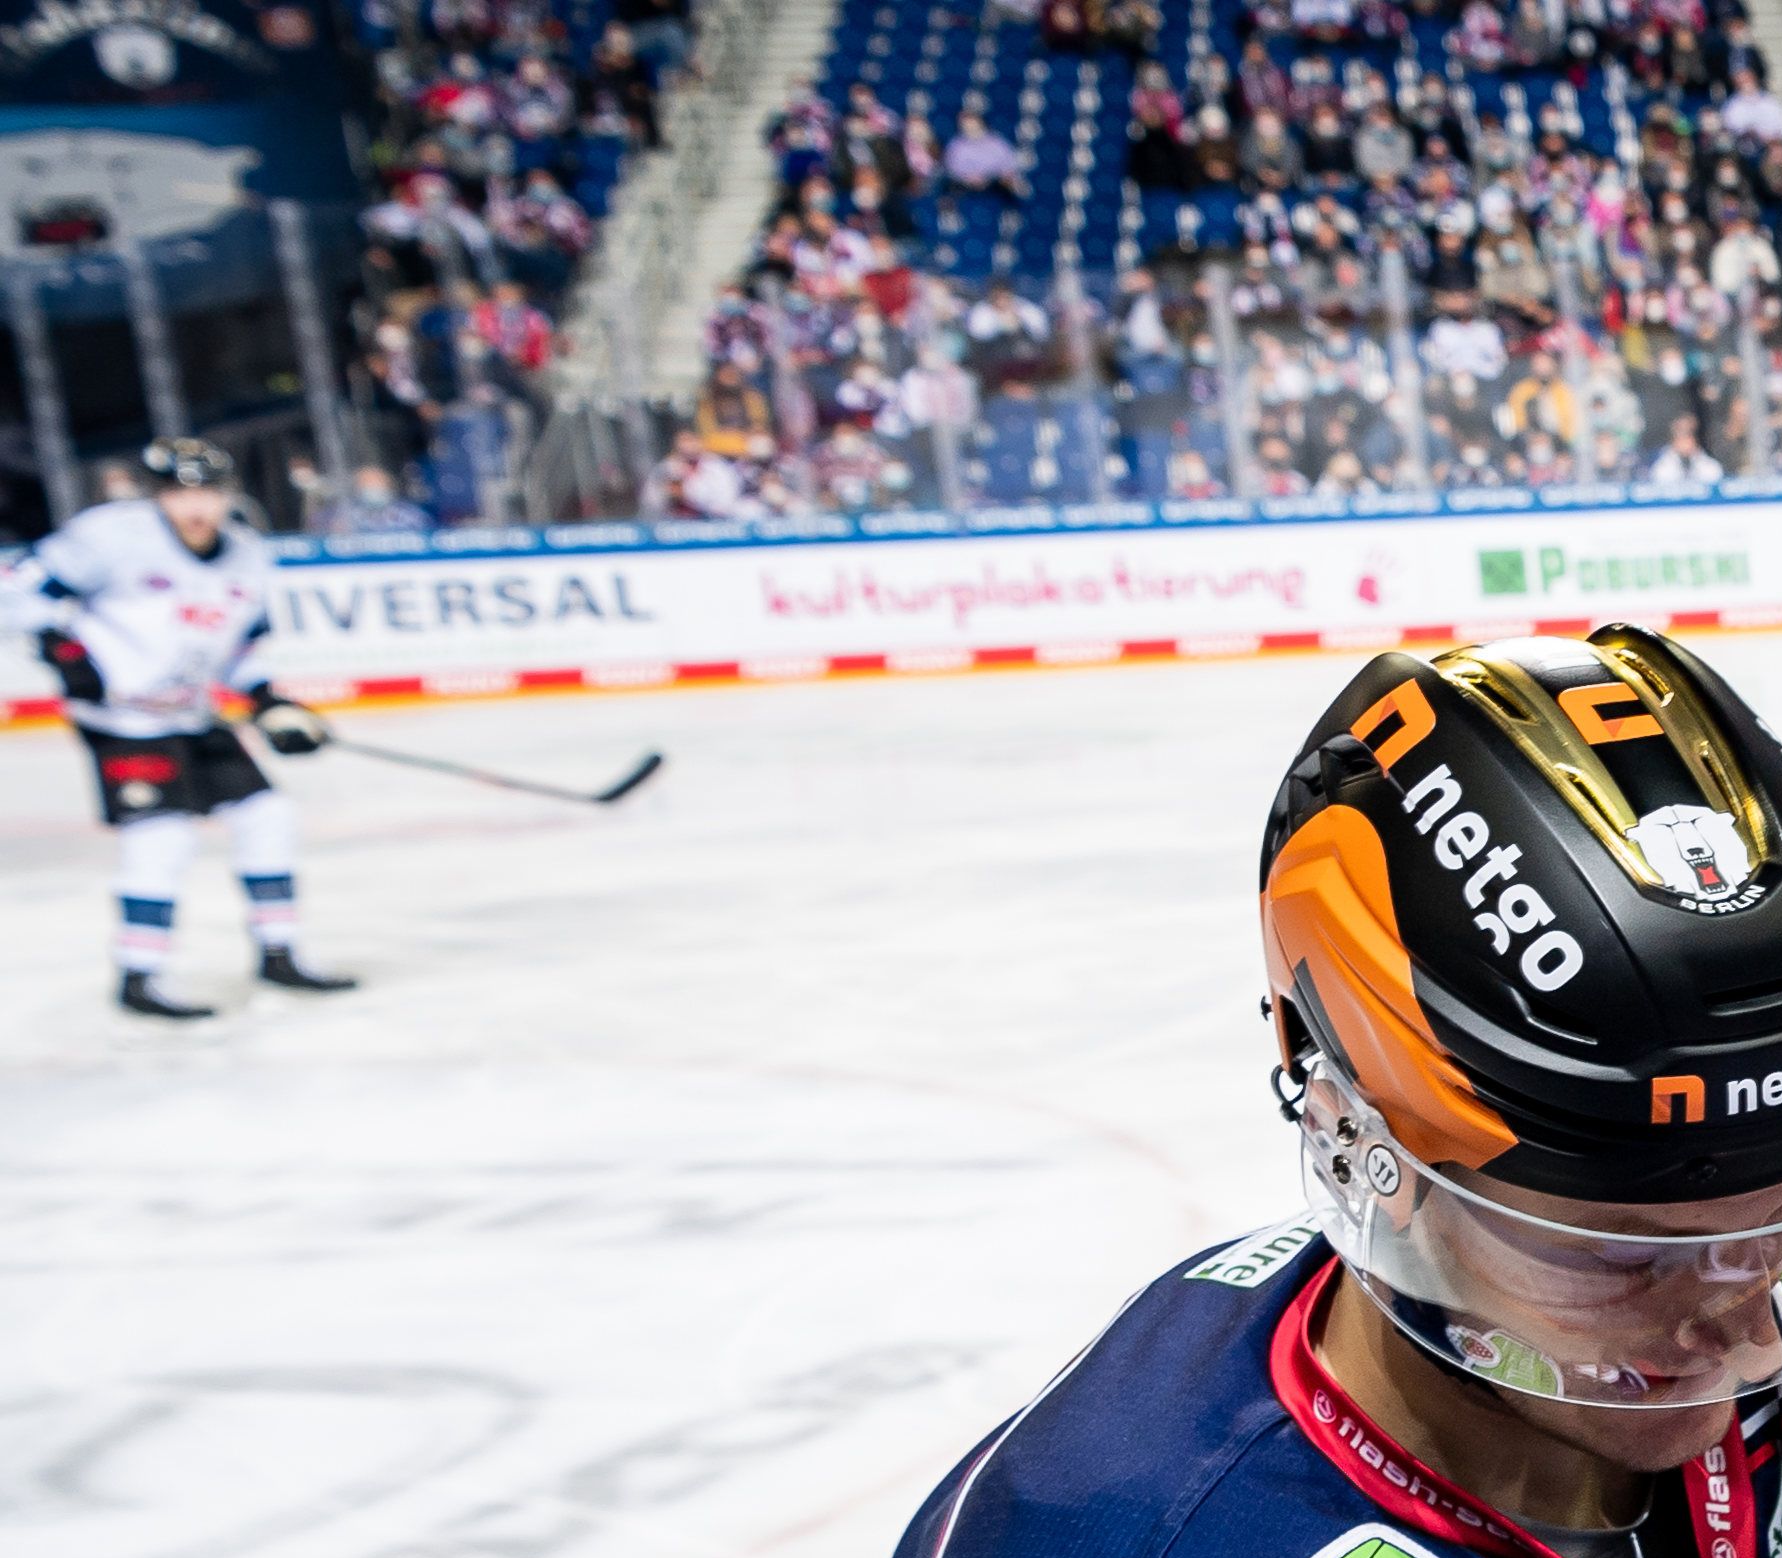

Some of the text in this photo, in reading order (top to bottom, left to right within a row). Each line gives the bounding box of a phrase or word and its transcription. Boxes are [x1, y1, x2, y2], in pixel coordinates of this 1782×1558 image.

[282, 570, 655, 634] IVERSAL
[1401, 762, 1584, 994] netgo
[1679, 884, 1768, 916] BERLIN
